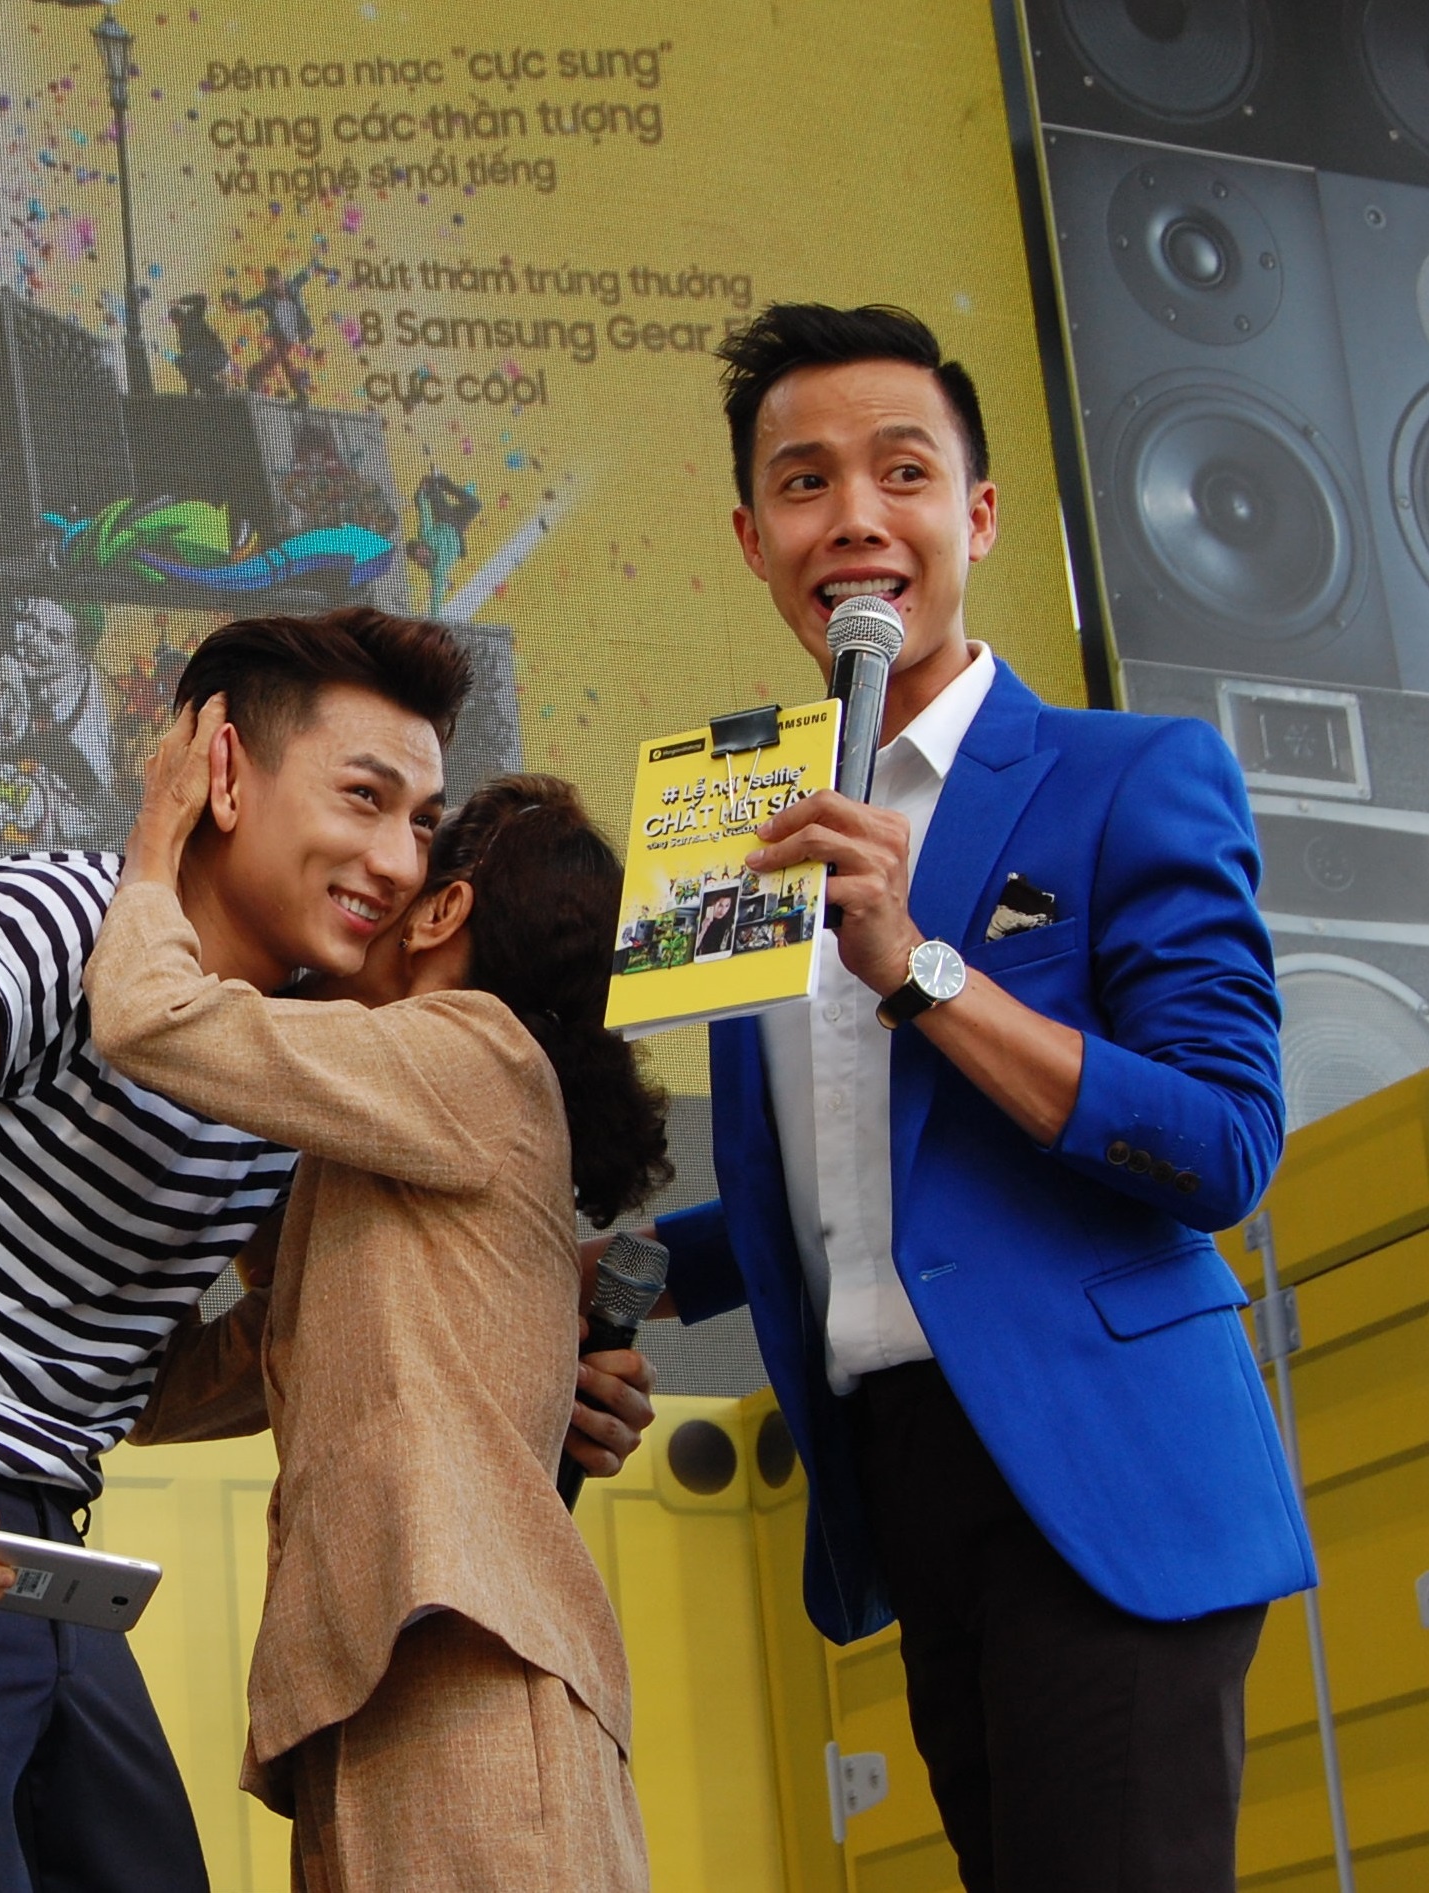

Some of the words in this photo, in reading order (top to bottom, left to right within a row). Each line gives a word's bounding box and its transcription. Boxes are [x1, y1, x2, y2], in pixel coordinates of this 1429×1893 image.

[206, 58, 290, 92] Đêm
[300, 63, 346, 88] ca
[353, 56, 445, 93] nhạc
[209, 107, 321, 160] cùng
[334, 102, 418, 143] các
[426, 92, 528, 140] thần
[537, 99, 663, 146] tượng
[269, 157, 360, 203] nghệ
[465, 146, 557, 193] tiếng
[354, 257, 412, 292] Rút
[419, 259, 518, 294] thăm
[525, 261, 621, 306] trúng
[628, 262, 753, 310] thưởng
[359, 310, 384, 346] 8
[394, 310, 598, 364] Samsung
[606, 314, 714, 352] Gear
[365, 369, 444, 414] cực
[456, 368, 549, 405] cool
[777, 712, 828, 731] AMSUNG
